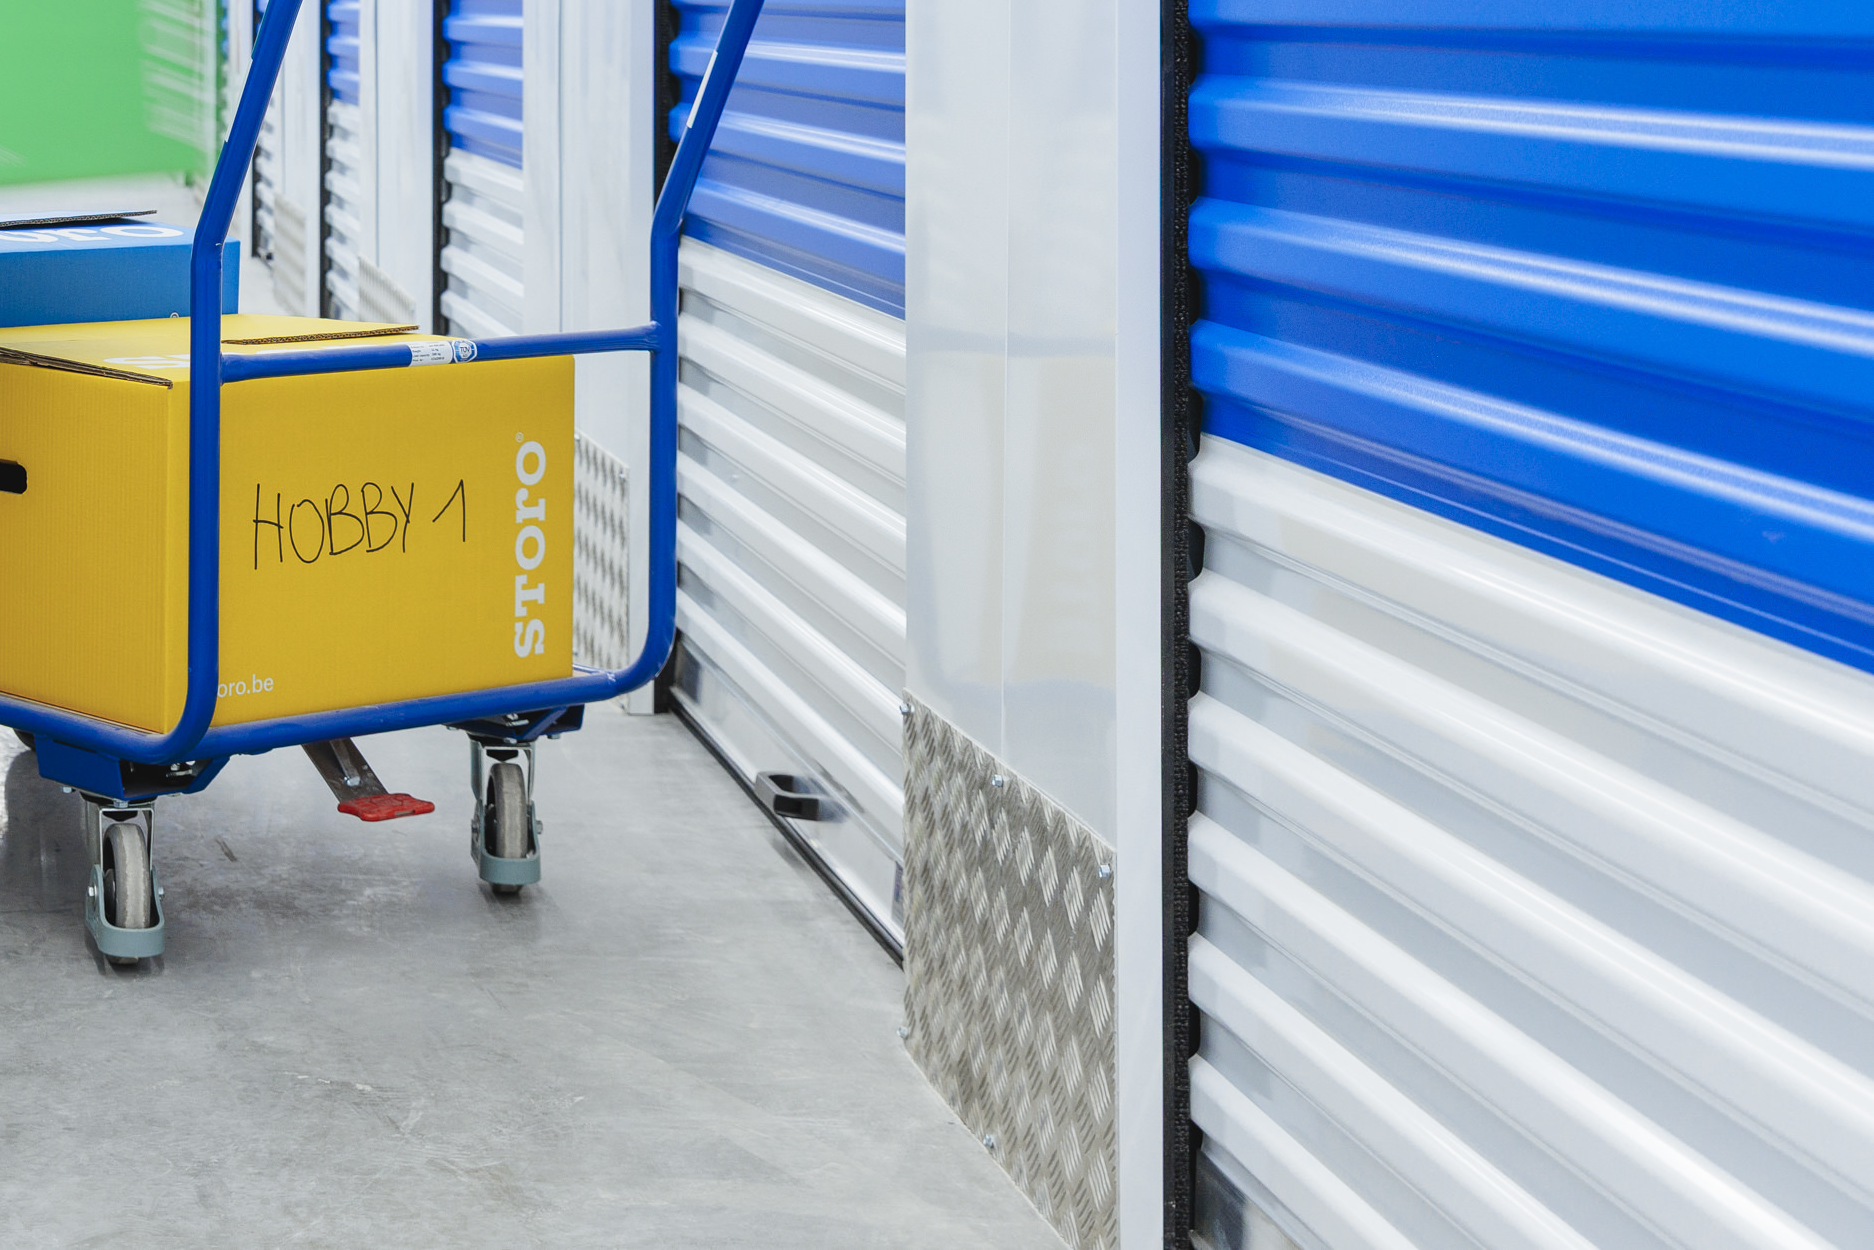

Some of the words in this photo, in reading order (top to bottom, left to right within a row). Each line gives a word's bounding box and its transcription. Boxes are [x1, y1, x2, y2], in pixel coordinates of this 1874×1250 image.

[253, 482, 414, 570] HOBBY
[432, 479, 465, 542] 1
[217, 673, 274, 698] oro.be
